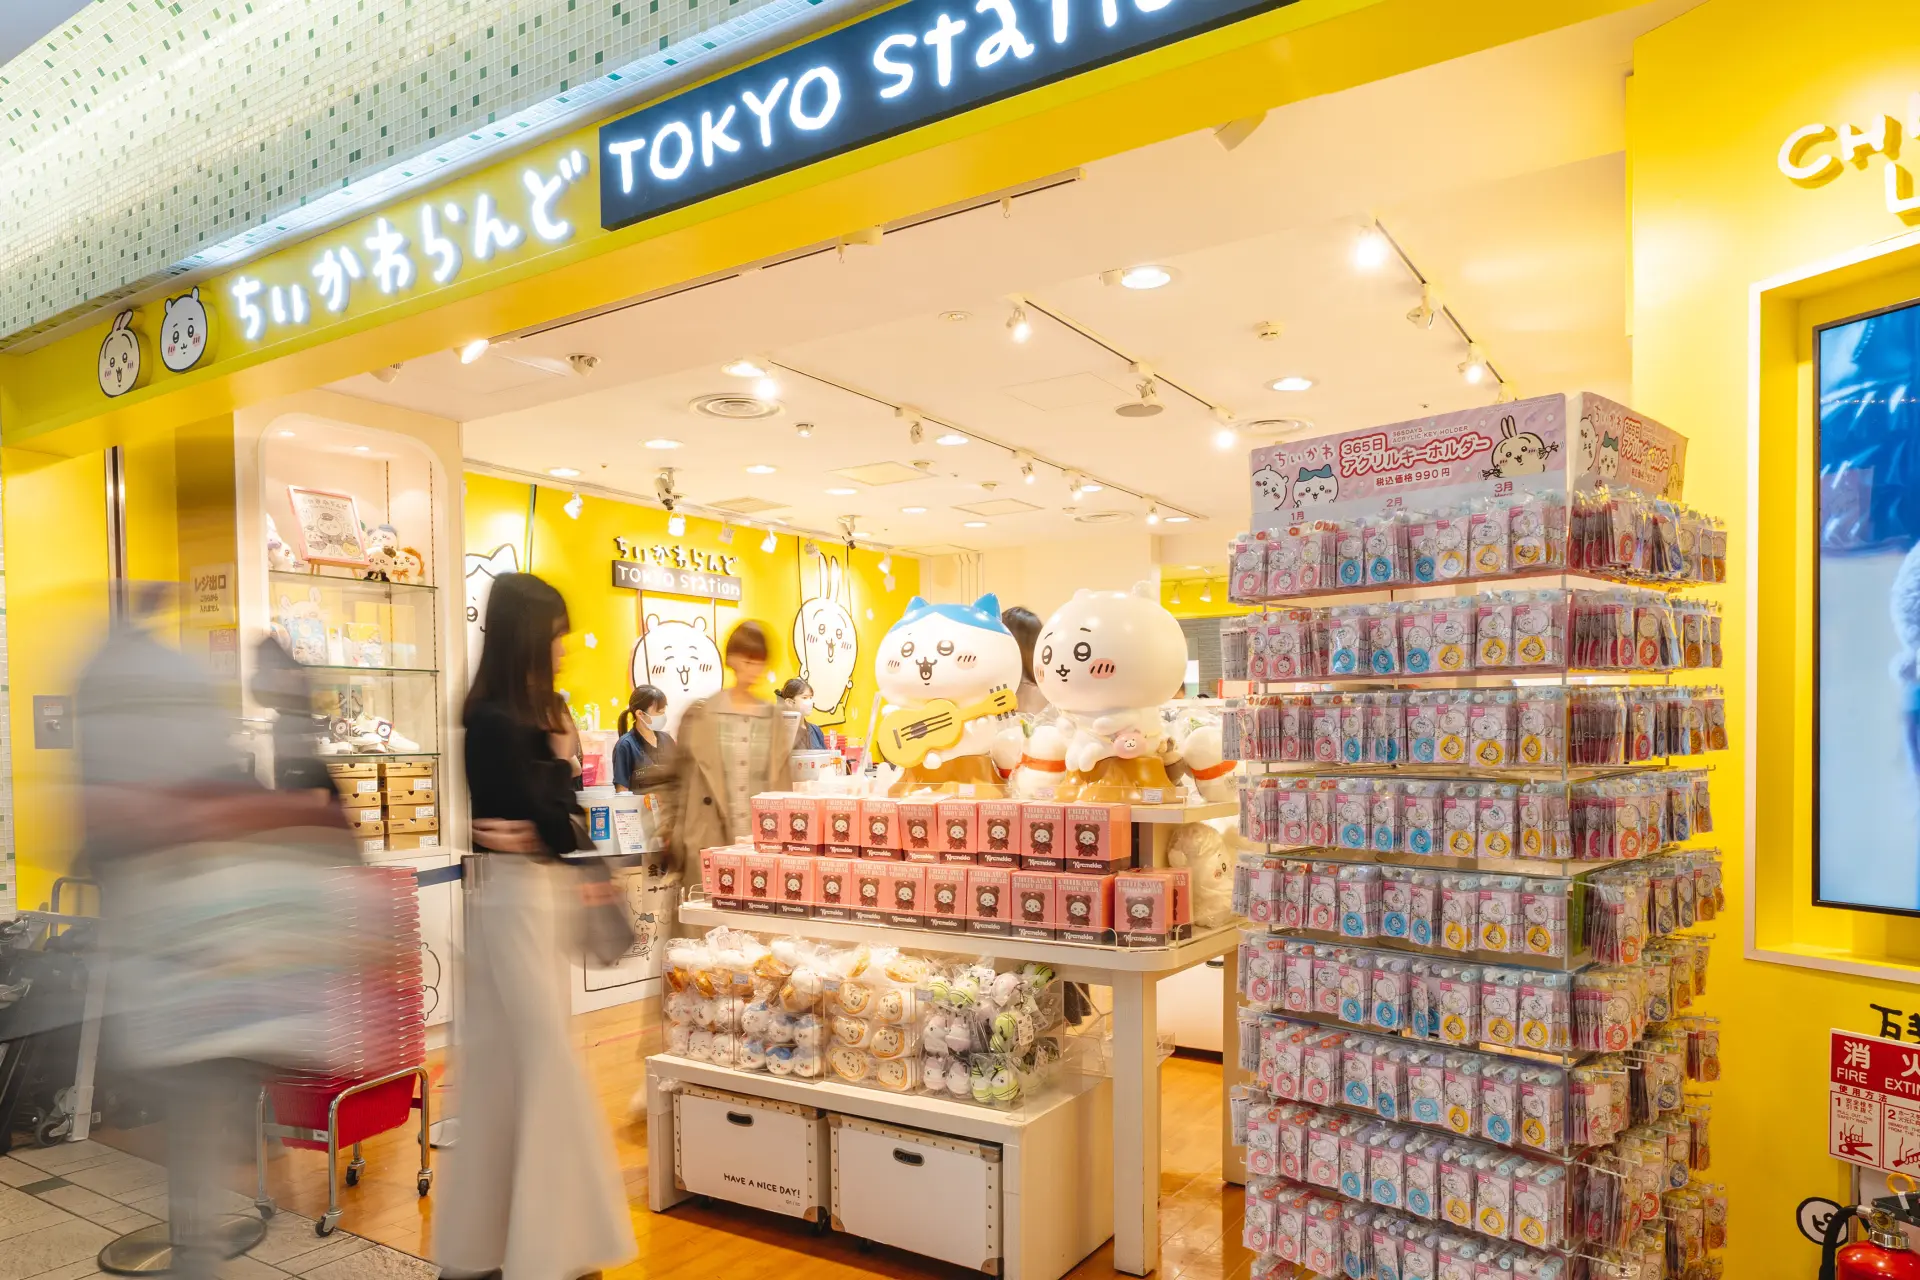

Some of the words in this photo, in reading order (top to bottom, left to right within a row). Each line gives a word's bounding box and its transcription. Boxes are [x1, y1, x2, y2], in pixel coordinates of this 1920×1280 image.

[608, 65, 842, 194] TOKYO
[231, 150, 584, 341] ちいかわらんど
[1423, 430, 1438, 439] KEY
[1440, 425, 1469, 435] HOLDER
[1274, 443, 1334, 467] ちいかわ
[1343, 439, 1384, 455] 365日
[1343, 436, 1490, 475] アクリルキーホルダー
[1494, 481, 1514, 493] 3月
[1386, 497, 1403, 508] 2月
[1290, 511, 1305, 521] 1月
[613, 535, 739, 576] ちいかわらんど
[194, 574, 227, 593] レジ出口
[1836, 1066, 1868, 1085] FIRE
[1835, 1096, 1841, 1107] 1
[1839, 1084, 1887, 1103] 使用方法
[1887, 1108, 1897, 1120] 2
[723, 1172, 746, 1185] HAVE
[748, 1179, 755, 1187] A
[756, 1181, 778, 1193] NICE
[779, 1185, 801, 1199] DAY!
